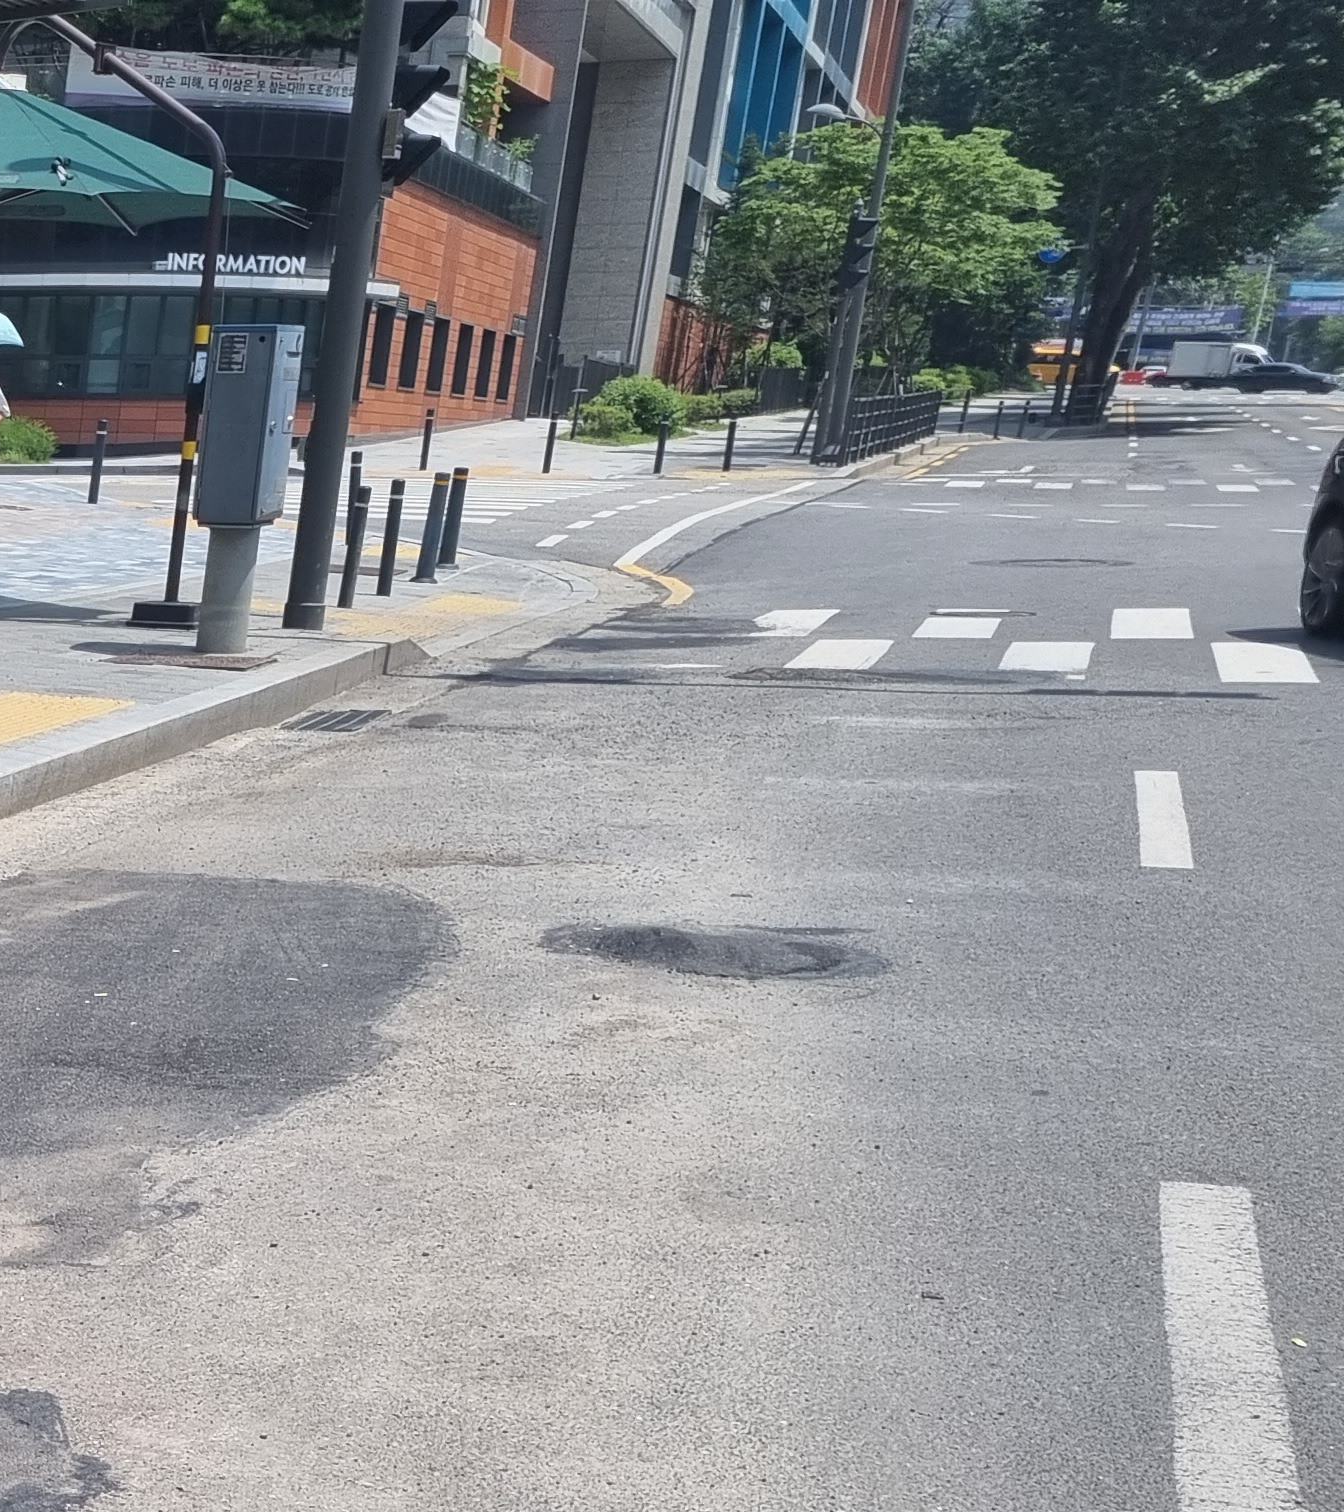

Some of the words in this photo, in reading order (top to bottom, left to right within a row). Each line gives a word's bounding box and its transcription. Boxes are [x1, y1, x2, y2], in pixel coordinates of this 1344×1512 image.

[180, 75, 205, 90] 피해,
[208, 77, 218, 89] 더
[222, 78, 253, 93] 이상은
